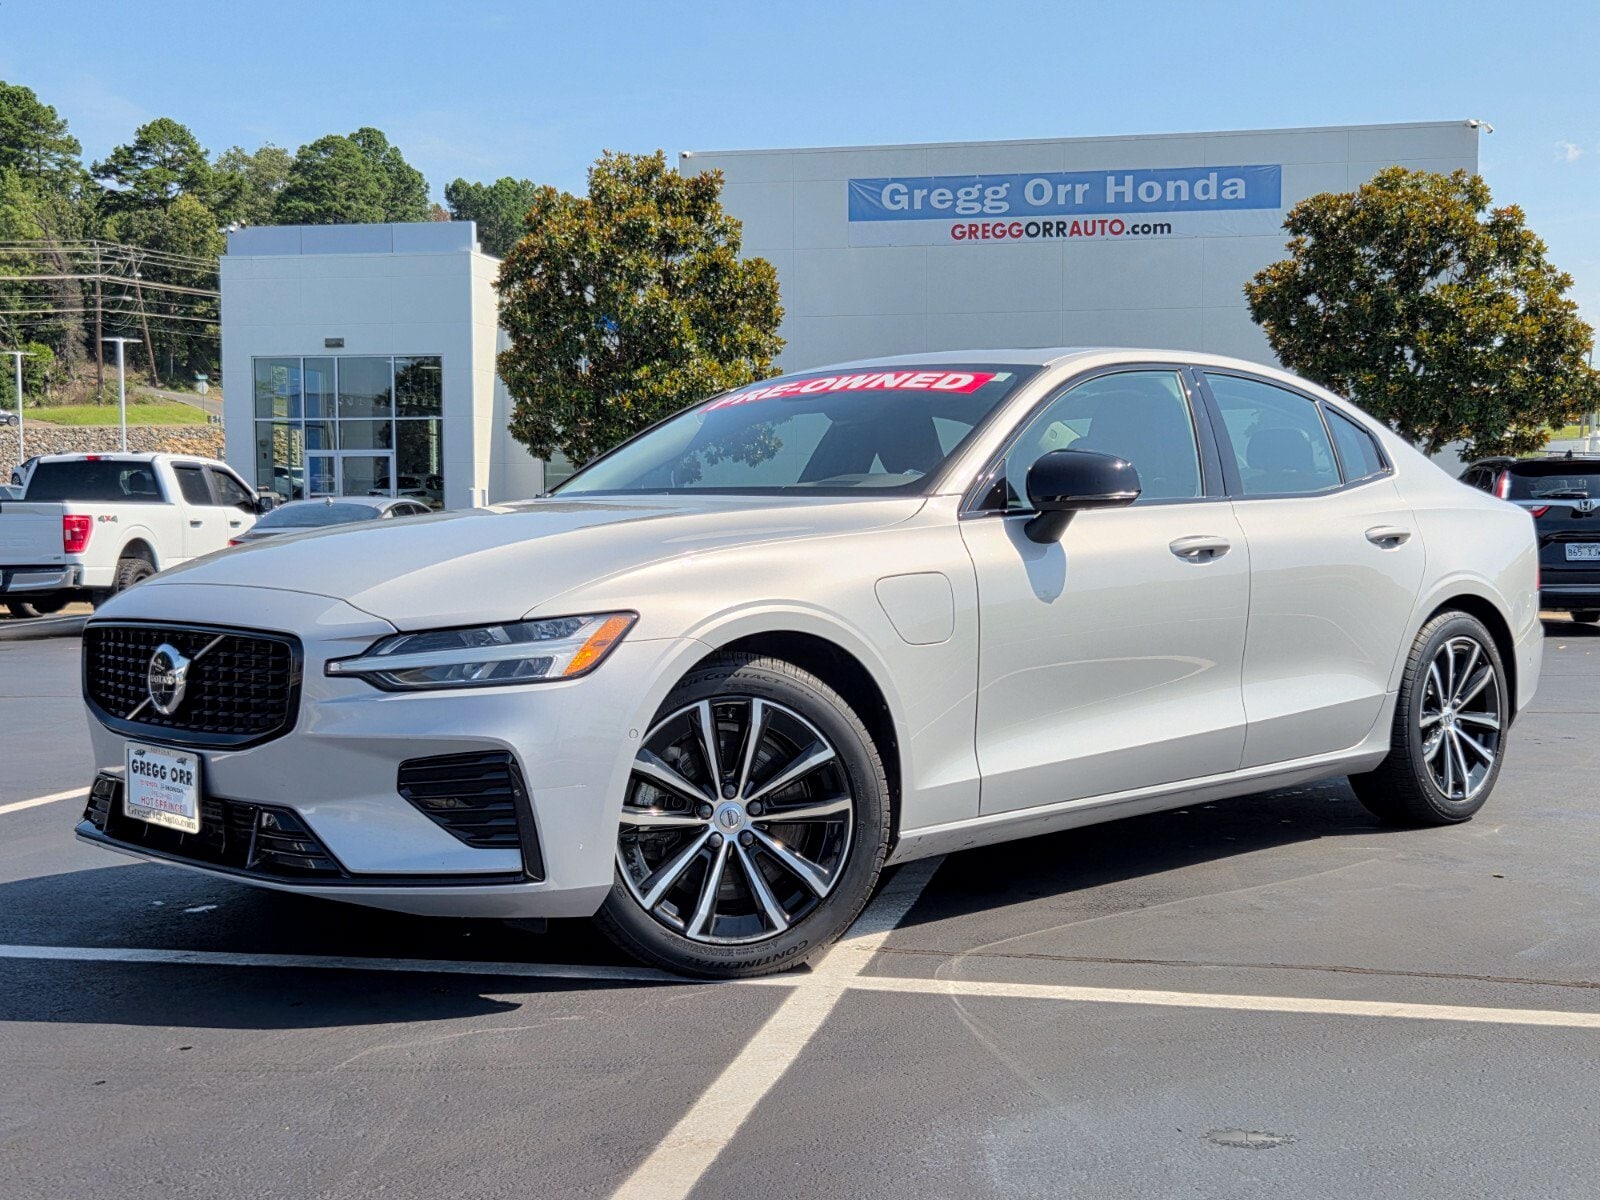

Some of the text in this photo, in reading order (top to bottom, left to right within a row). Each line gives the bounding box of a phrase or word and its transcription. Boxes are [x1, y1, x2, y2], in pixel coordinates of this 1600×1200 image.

[881, 172, 1246, 215] Gregg Orr Honda
[950, 218, 1172, 241] GREGGORRAUTO.com
[706, 372, 975, 412] PRE-OWNED
[131, 759, 193, 786] GREGG ORR
[141, 796, 154, 807] HOT
[685, 940, 809, 969] CONTINENTAL
